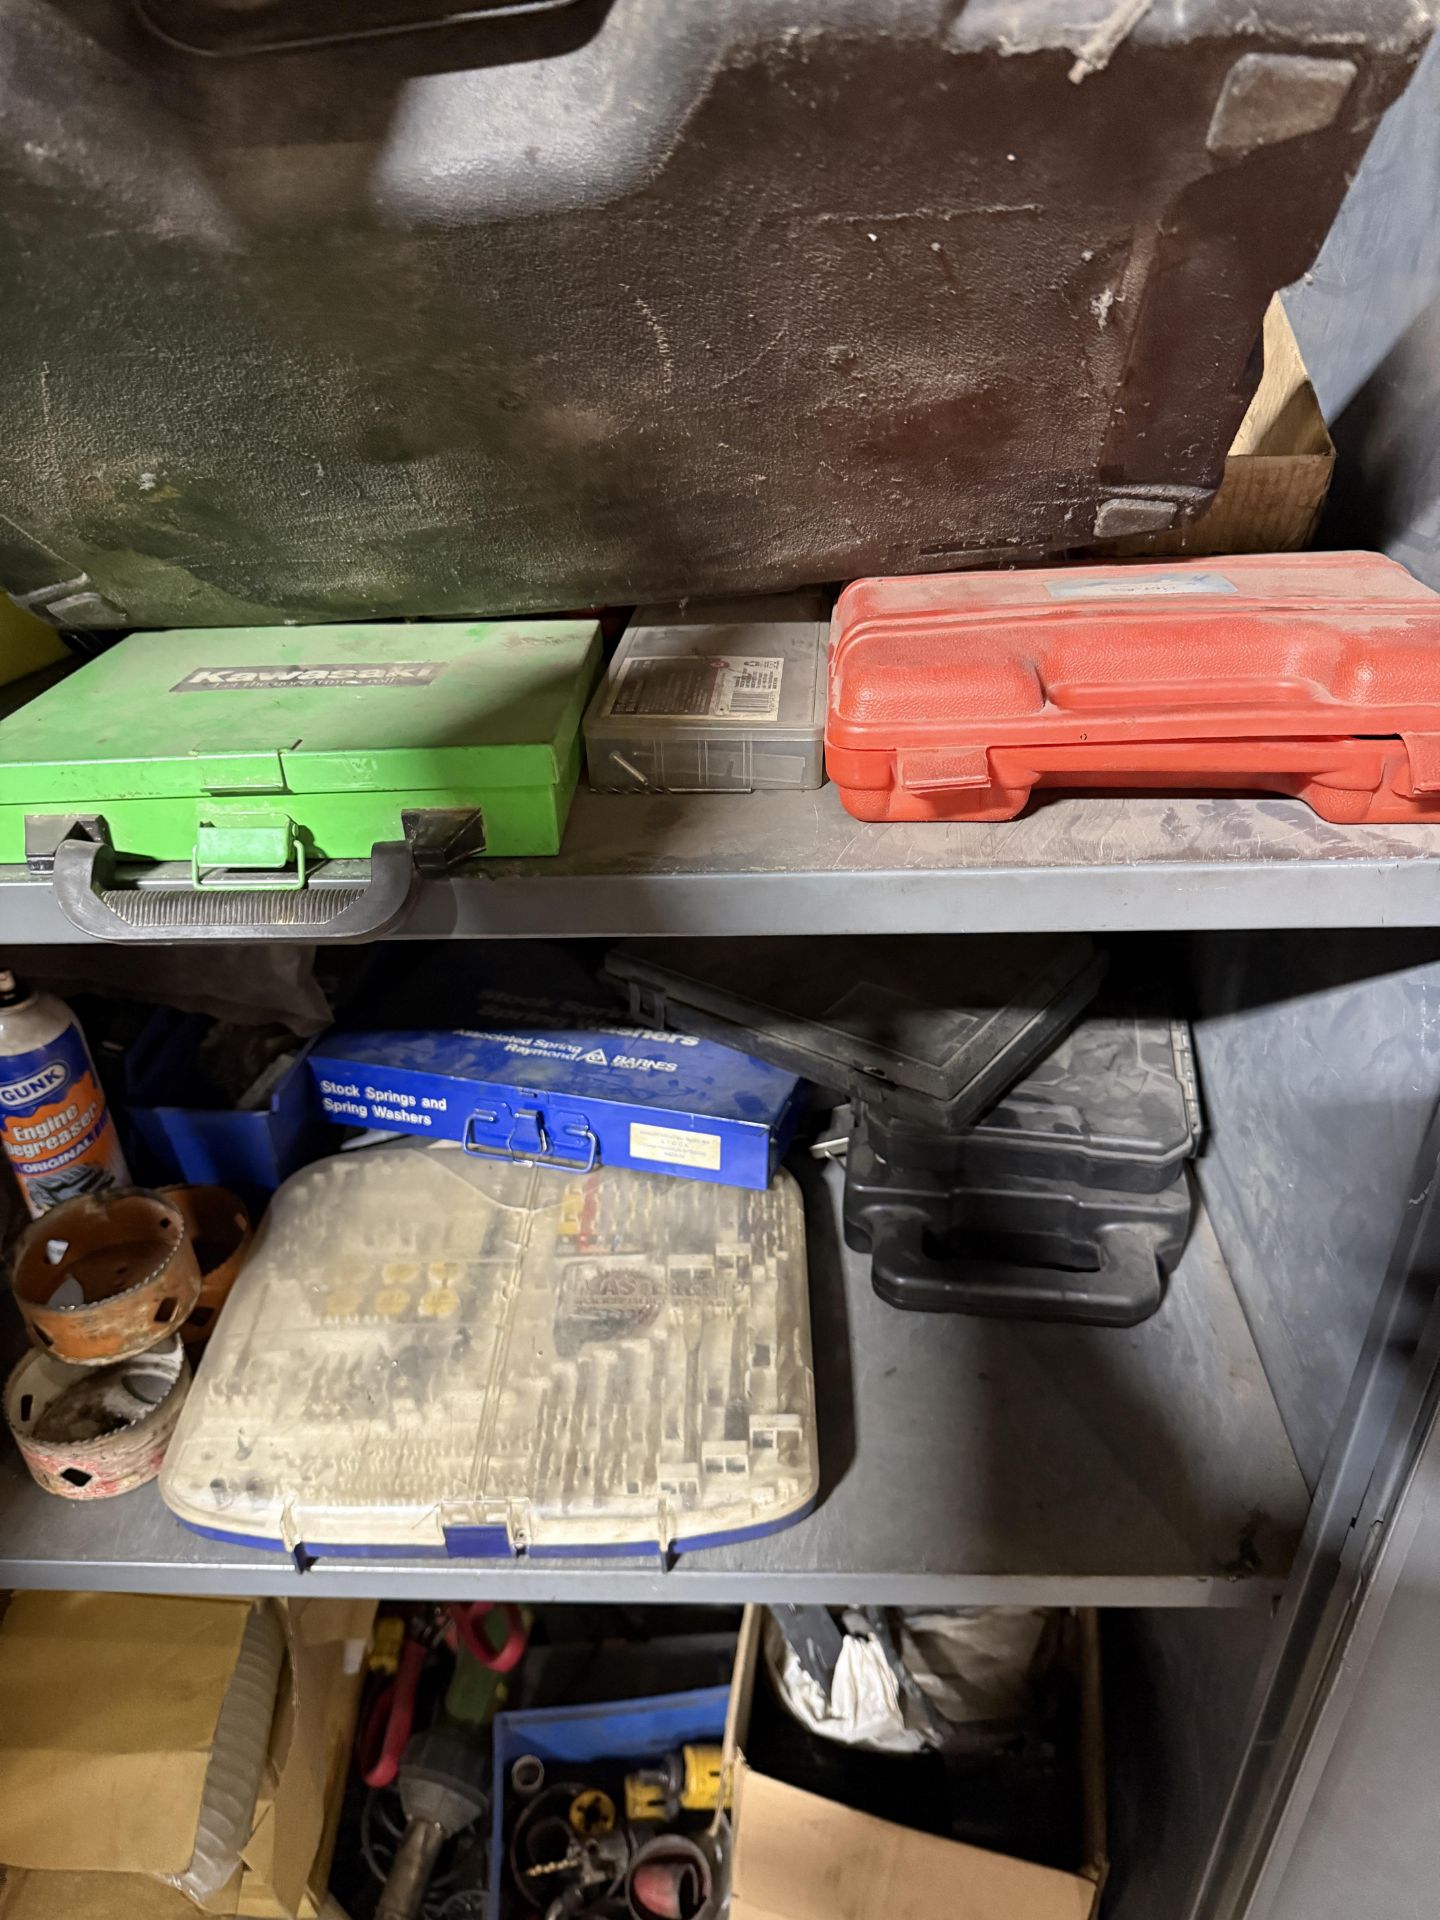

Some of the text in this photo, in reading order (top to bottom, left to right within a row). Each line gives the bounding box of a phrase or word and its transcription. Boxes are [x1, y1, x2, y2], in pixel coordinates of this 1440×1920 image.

[188, 668, 432, 683] Kawasaki
[504, 1044, 579, 1061] Raymond
[534, 1038, 583, 1054] Spring
[612, 1054, 678, 1072] BARNES
[1, 1069, 61, 1102] GUNK
[320, 1080, 447, 1112] Stock Springs and
[12, 1104, 78, 1142] Engine
[322, 1098, 432, 1127] Spring Washers
[22, 1138, 94, 1173] ORIGINAL
